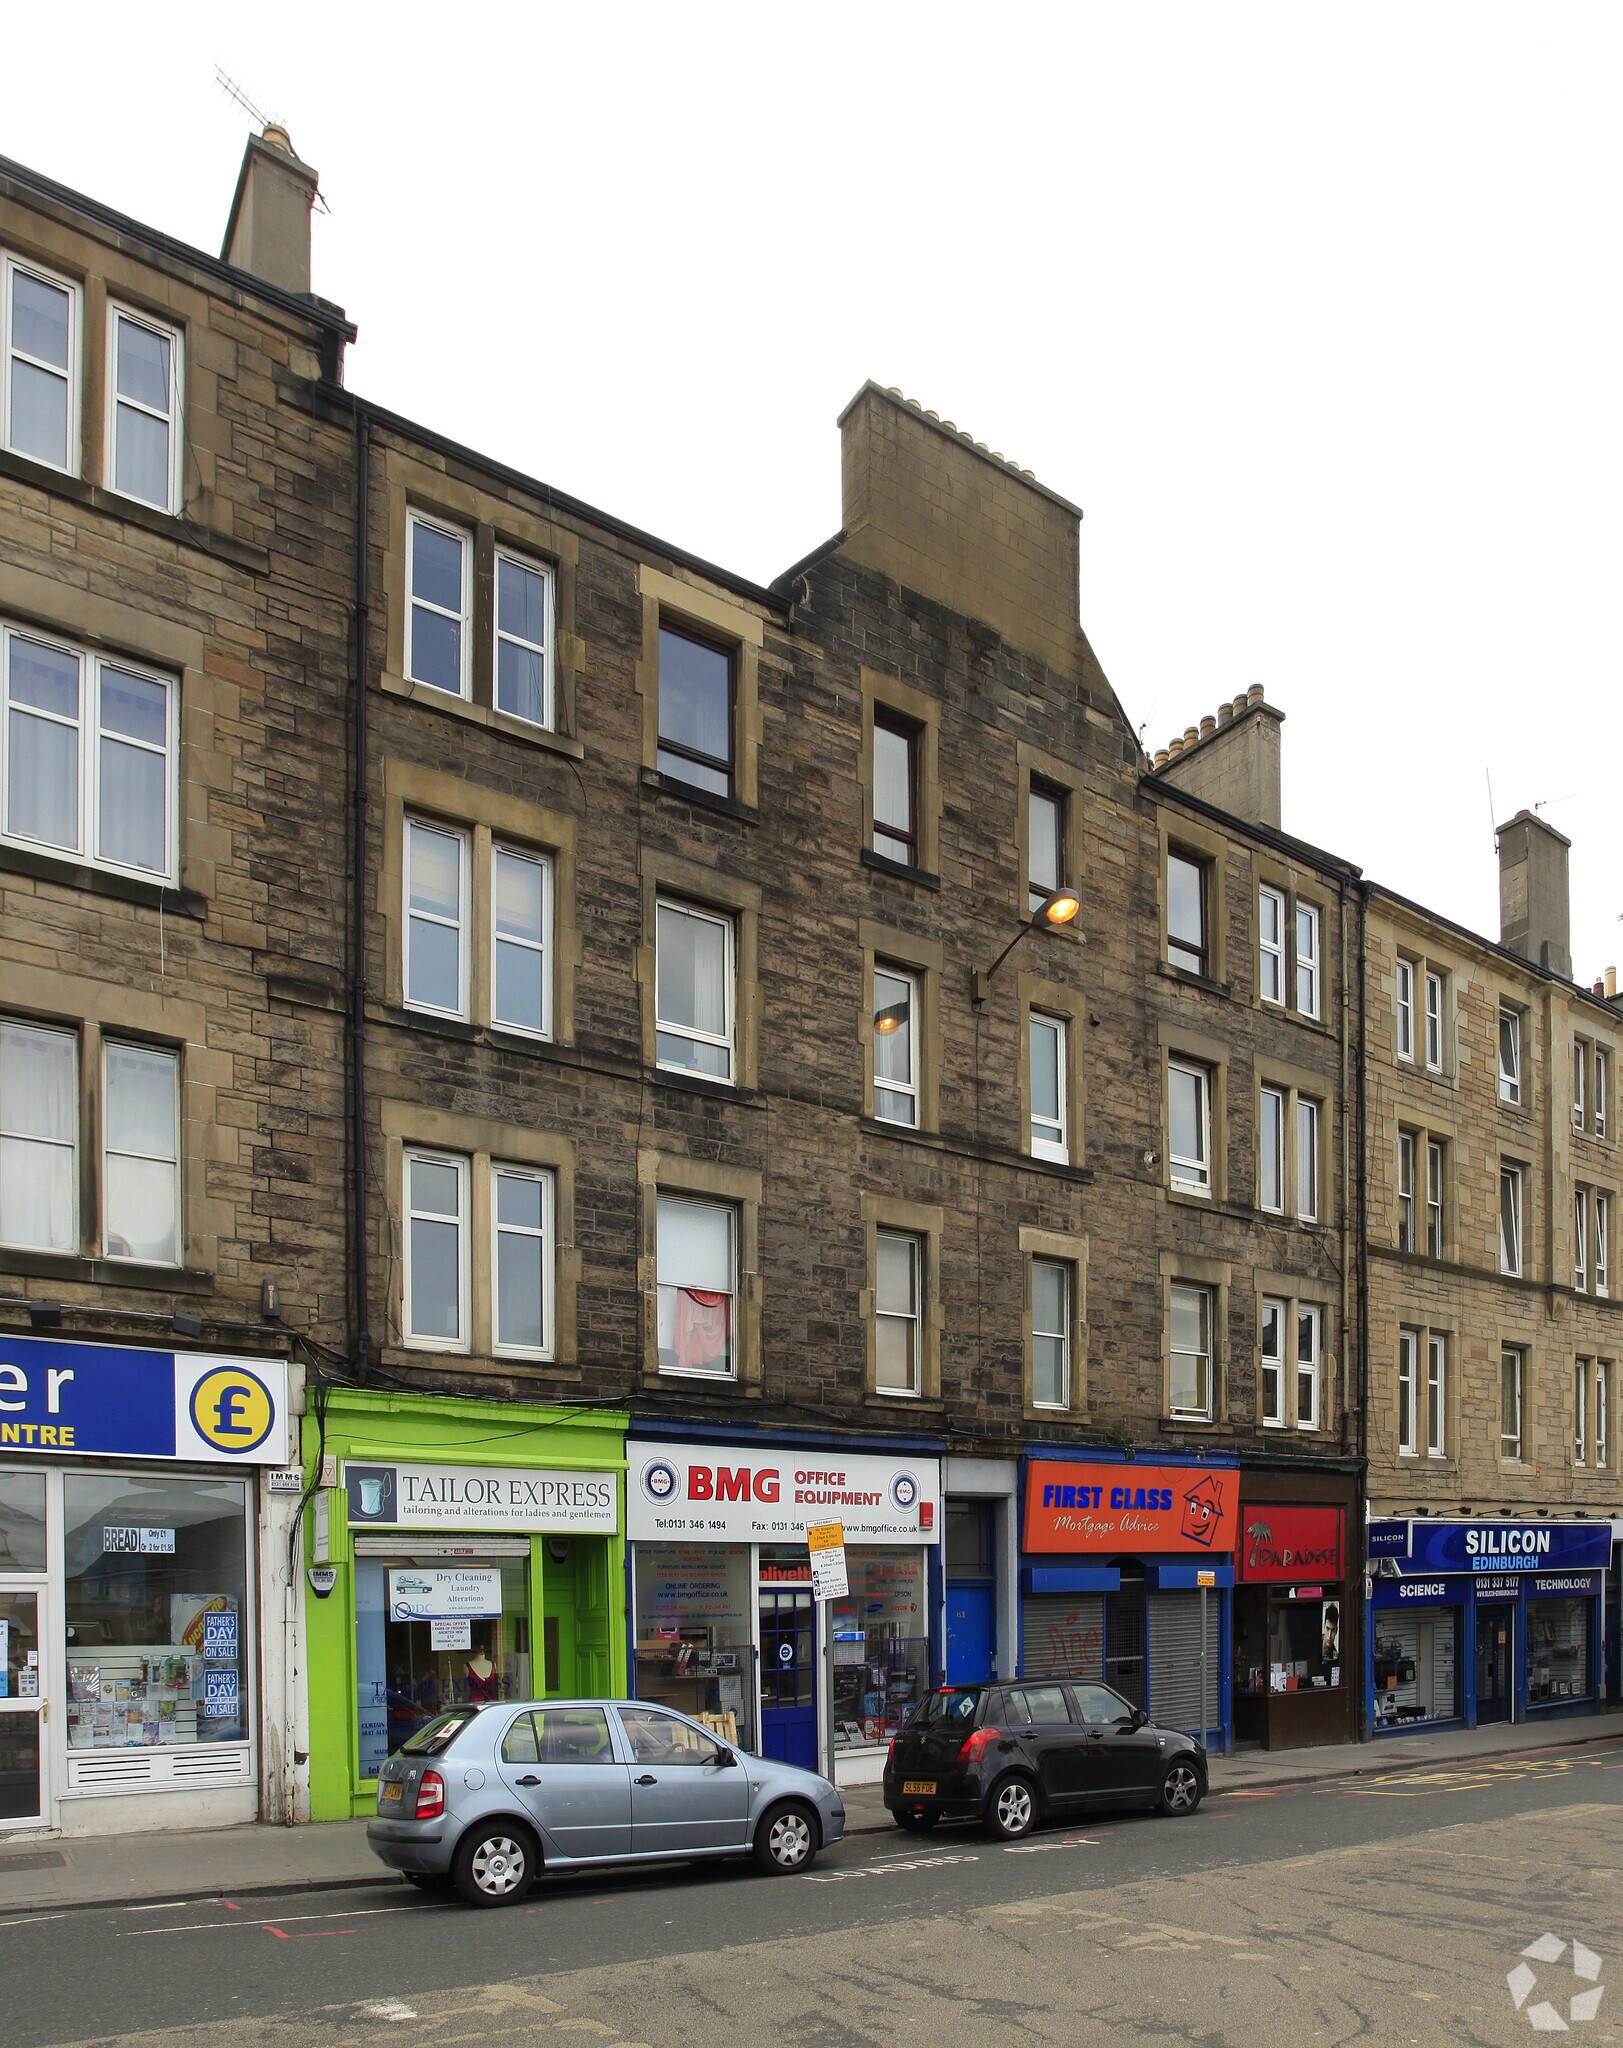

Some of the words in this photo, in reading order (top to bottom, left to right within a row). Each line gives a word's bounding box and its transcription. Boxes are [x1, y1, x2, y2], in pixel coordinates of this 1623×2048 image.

[270, 1473, 300, 1481] IMMS
[794, 1471, 846, 1486] OFFICE
[688, 1465, 781, 1504] BMG
[402, 1475, 502, 1504] TAILOR
[508, 1480, 611, 1508] EXPRESS
[794, 1490, 883, 1506] EQUIPMENT
[1043, 1485, 1103, 1508] FIRST
[1110, 1487, 1173, 1511] CLASS
[403, 1505, 442, 1517] tailoring
[444, 1506, 461, 1515] and
[463, 1507, 508, 1517] alterations
[511, 1508, 523, 1517] for
[525, 1508, 550, 1518] ladies
[552, 1509, 567, 1518] and
[569, 1510, 611, 1520] gentlemen
[689, 1520, 705, 1530] 346
[708, 1520, 727, 1530] 1494
[752, 1521, 769, 1531] Fax:
[771, 1521, 788, 1532] 0131
[790, 1522, 805, 1532] 346
[1053, 1515, 1116, 1538] Mortgage
[1120, 1513, 1160, 1531] Advice
[104, 1528, 138, 1552] BREAD
[148, 1529, 160, 1539] Only
[161, 1529, 167, 1538] £1
[1371, 1534, 1404, 1543] SILICON
[141, 1543, 147, 1551] Or
[149, 1543, 153, 1551] 2
[1465, 1529, 1550, 1554] SILICON
[1472, 1555, 1539, 1570] EDINBURGH
[436, 1573, 452, 1583] Dry
[455, 1573, 492, 1583] Cleaning
[1476, 1577, 1490, 1589] 0131
[1491, 1576, 1504, 1588] 337
[1535, 1578, 1591, 1591] TECHNOLOGY
[451, 1584, 480, 1592] Laundry
[1399, 1583, 1446, 1598] SCIENCE
[657, 1590, 729, 1600] www.bmgoffice.co.uk
[206, 1616, 235, 1627] FATHER'S
[207, 1626, 235, 1639] DAY
[205, 1647, 217, 1657] ON
[218, 1647, 235, 1657] SALE
[207, 1673, 236, 1684] FATHER'S
[207, 1684, 236, 1697] DAY
[206, 1703, 218, 1714] ON
[219, 1703, 236, 1715] SALE
